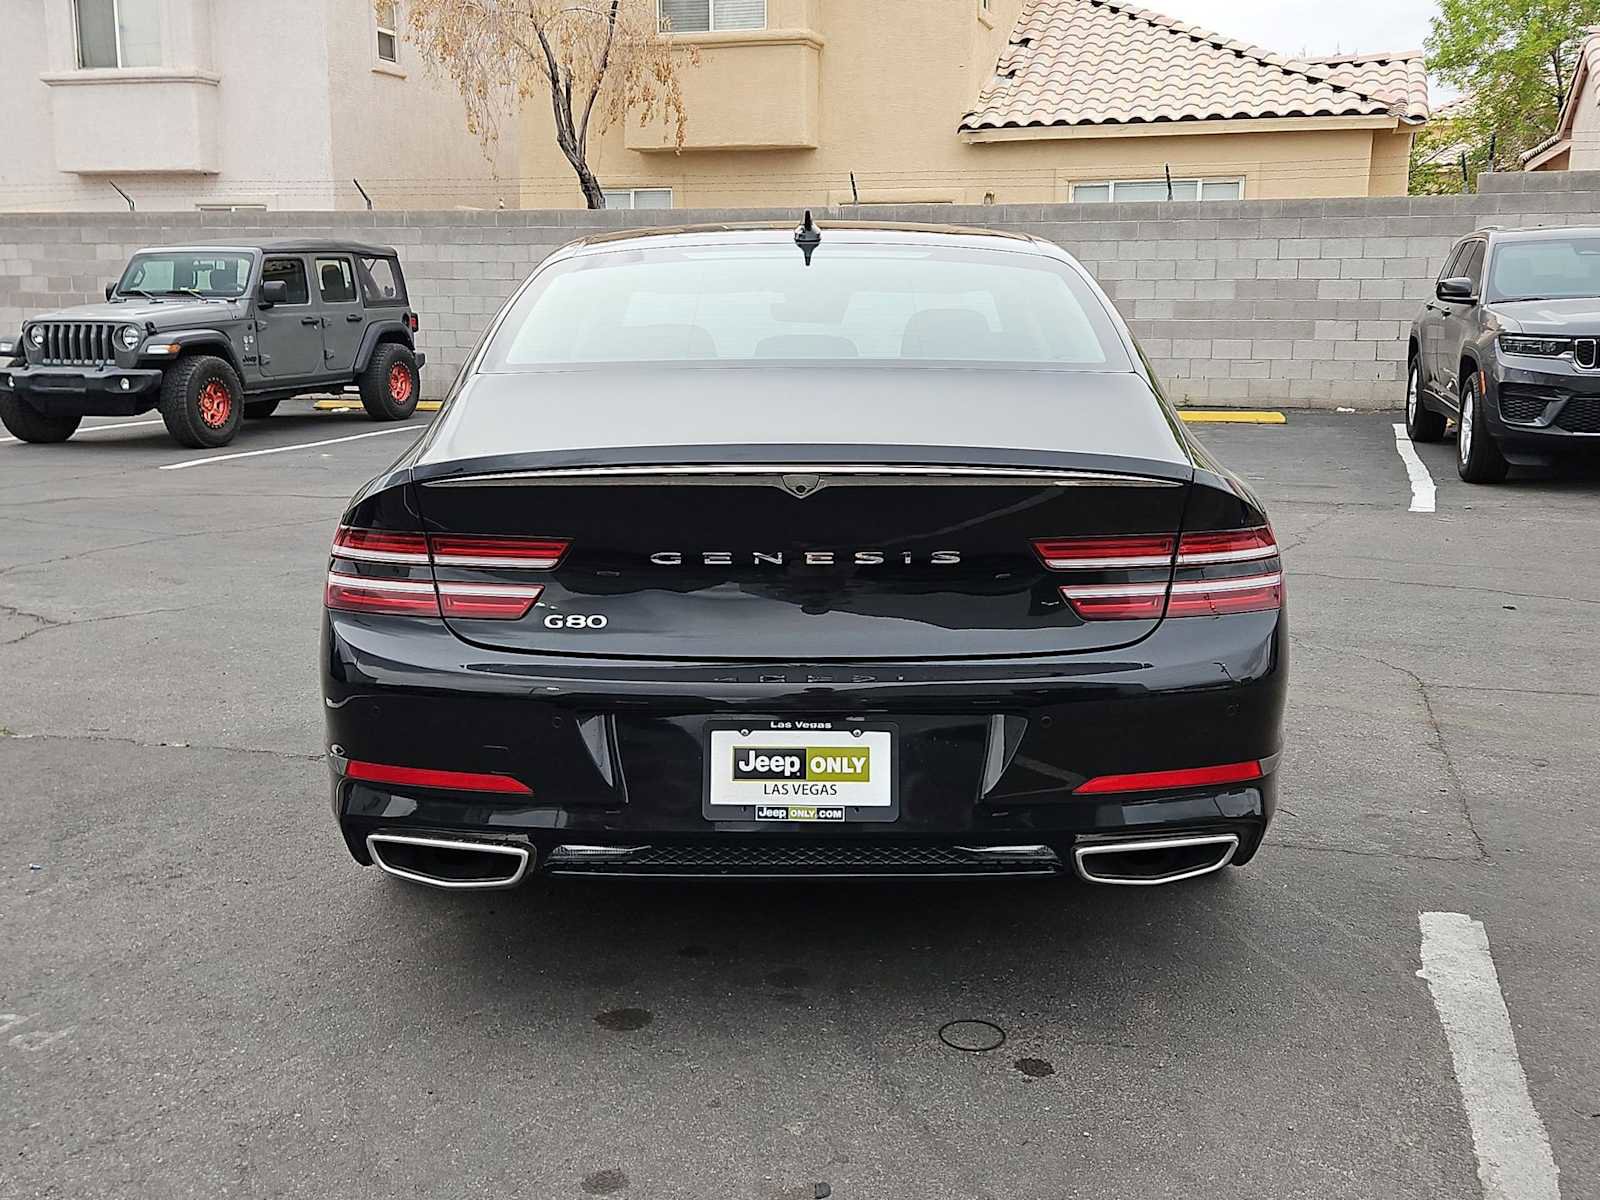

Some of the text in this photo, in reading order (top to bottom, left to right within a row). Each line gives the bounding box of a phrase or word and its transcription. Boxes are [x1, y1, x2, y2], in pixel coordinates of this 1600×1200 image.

[650, 551, 961, 565] GENESIS
[544, 615, 608, 629] G80
[770, 721, 832, 729] Las Vegas
[738, 750, 867, 776] Jeep ONLY
[764, 784, 838, 795] LAS VEGAS
